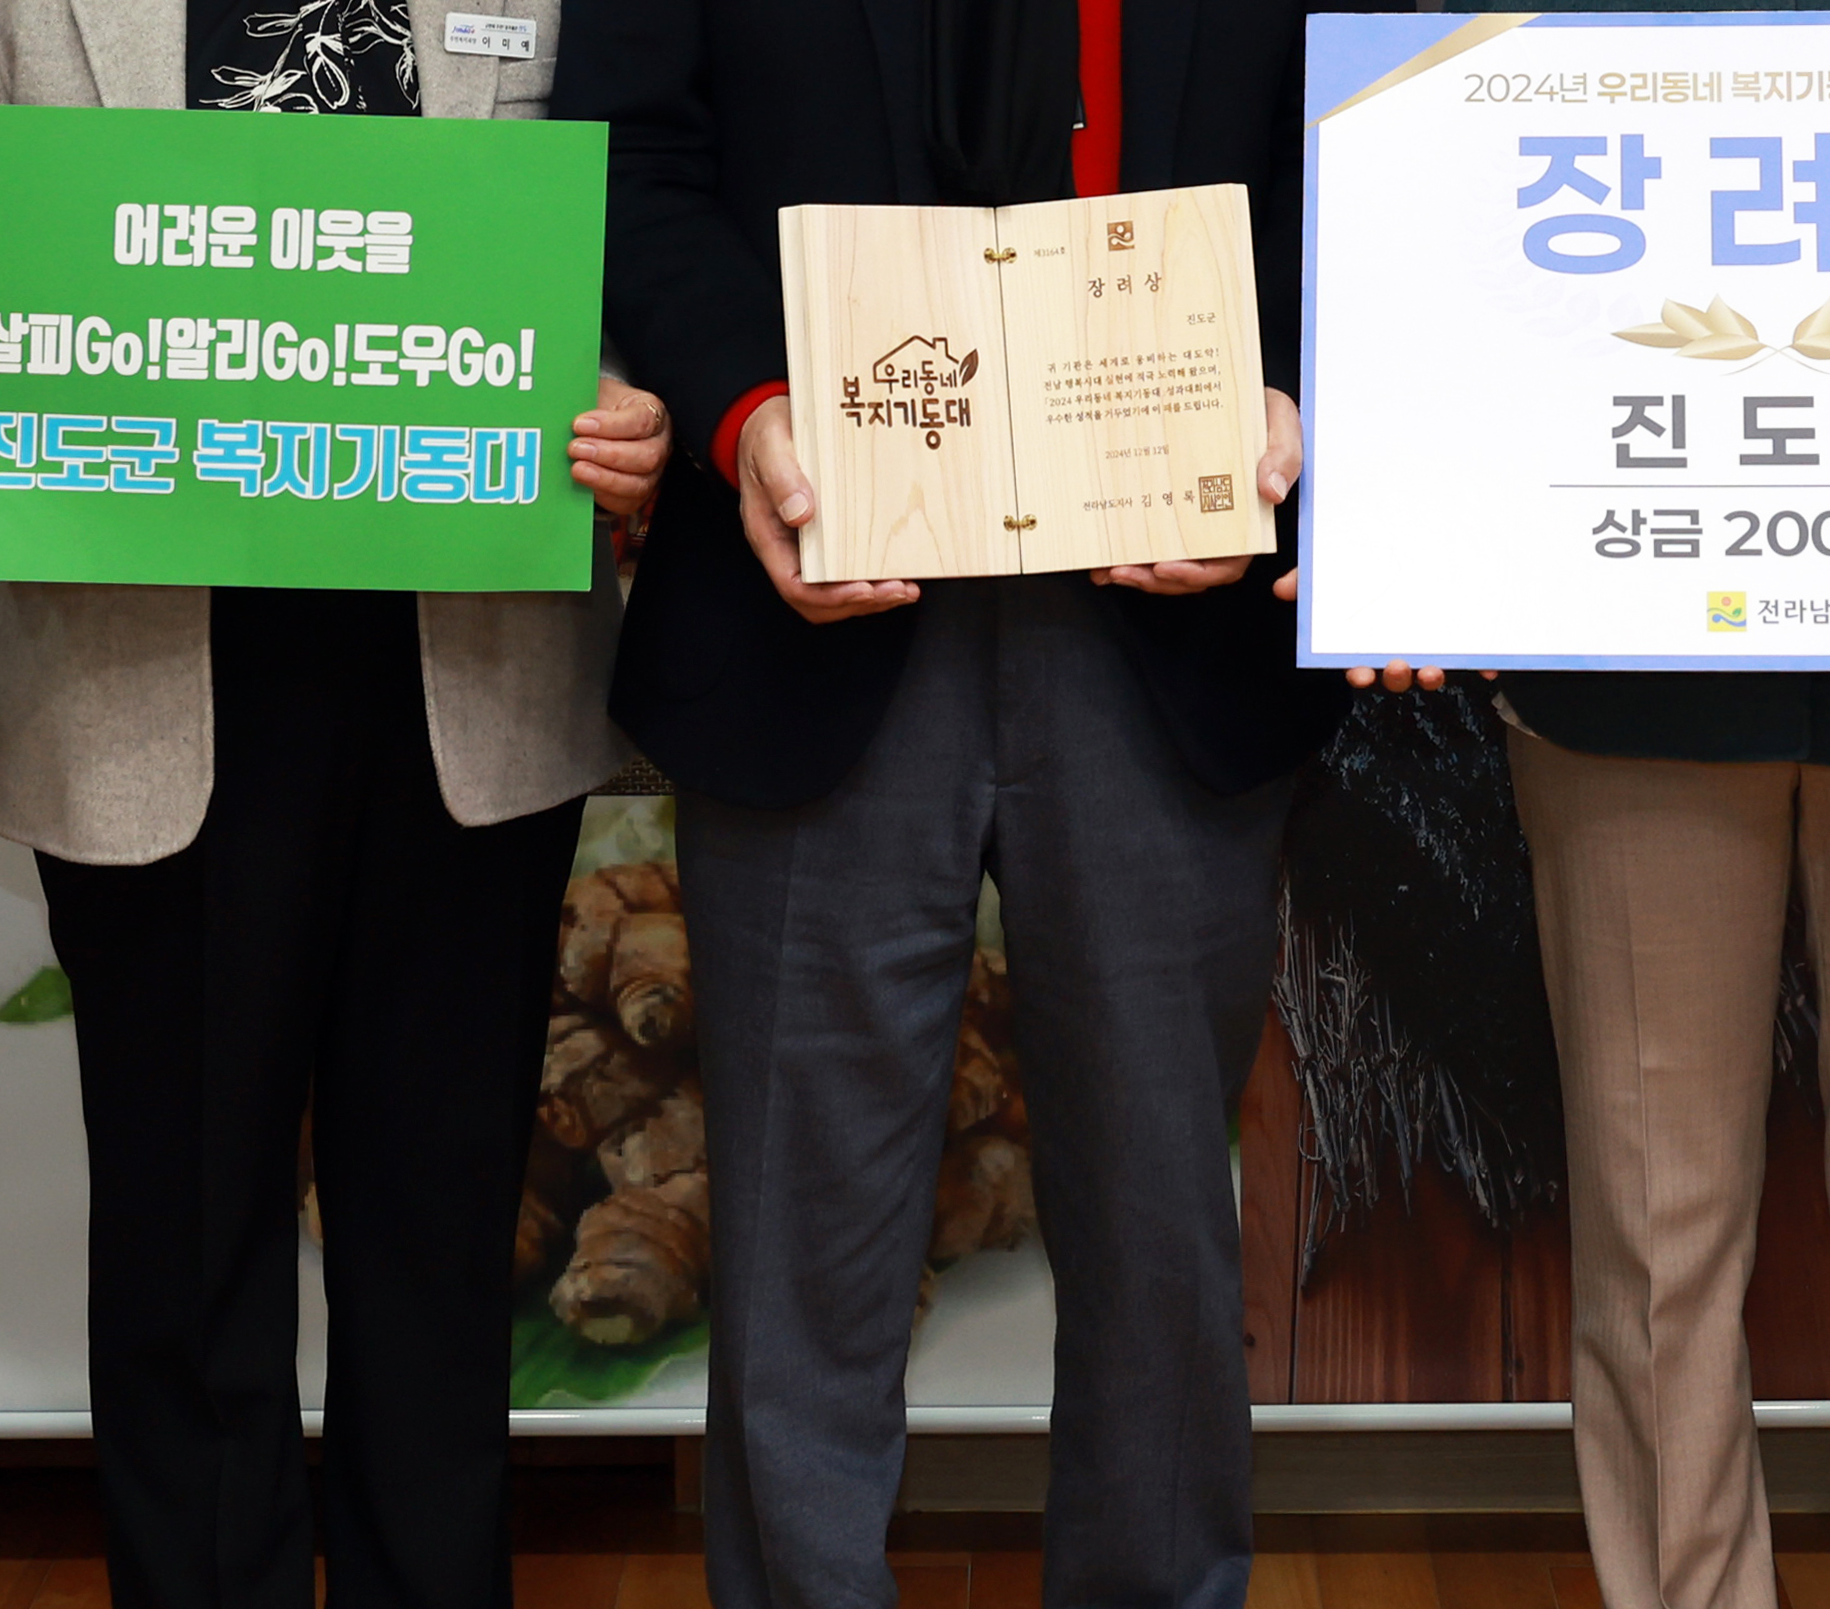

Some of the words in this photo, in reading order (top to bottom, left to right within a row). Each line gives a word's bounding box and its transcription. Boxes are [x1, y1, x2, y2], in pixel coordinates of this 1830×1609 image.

[1463, 72, 1588, 104] 2024년
[1596, 70, 1723, 105] 우리동네
[113, 202, 258, 269] 어려운
[269, 207, 414, 274] 이웃을
[1187, 312, 1216, 326] 진도군
[873, 360, 958, 395] 우리동네
[1075, 391, 1112, 405] 우리동네
[840, 376, 971, 450] 복지기동대
[191, 417, 542, 505] 복지기동대
[1591, 507, 1704, 559] 상금
